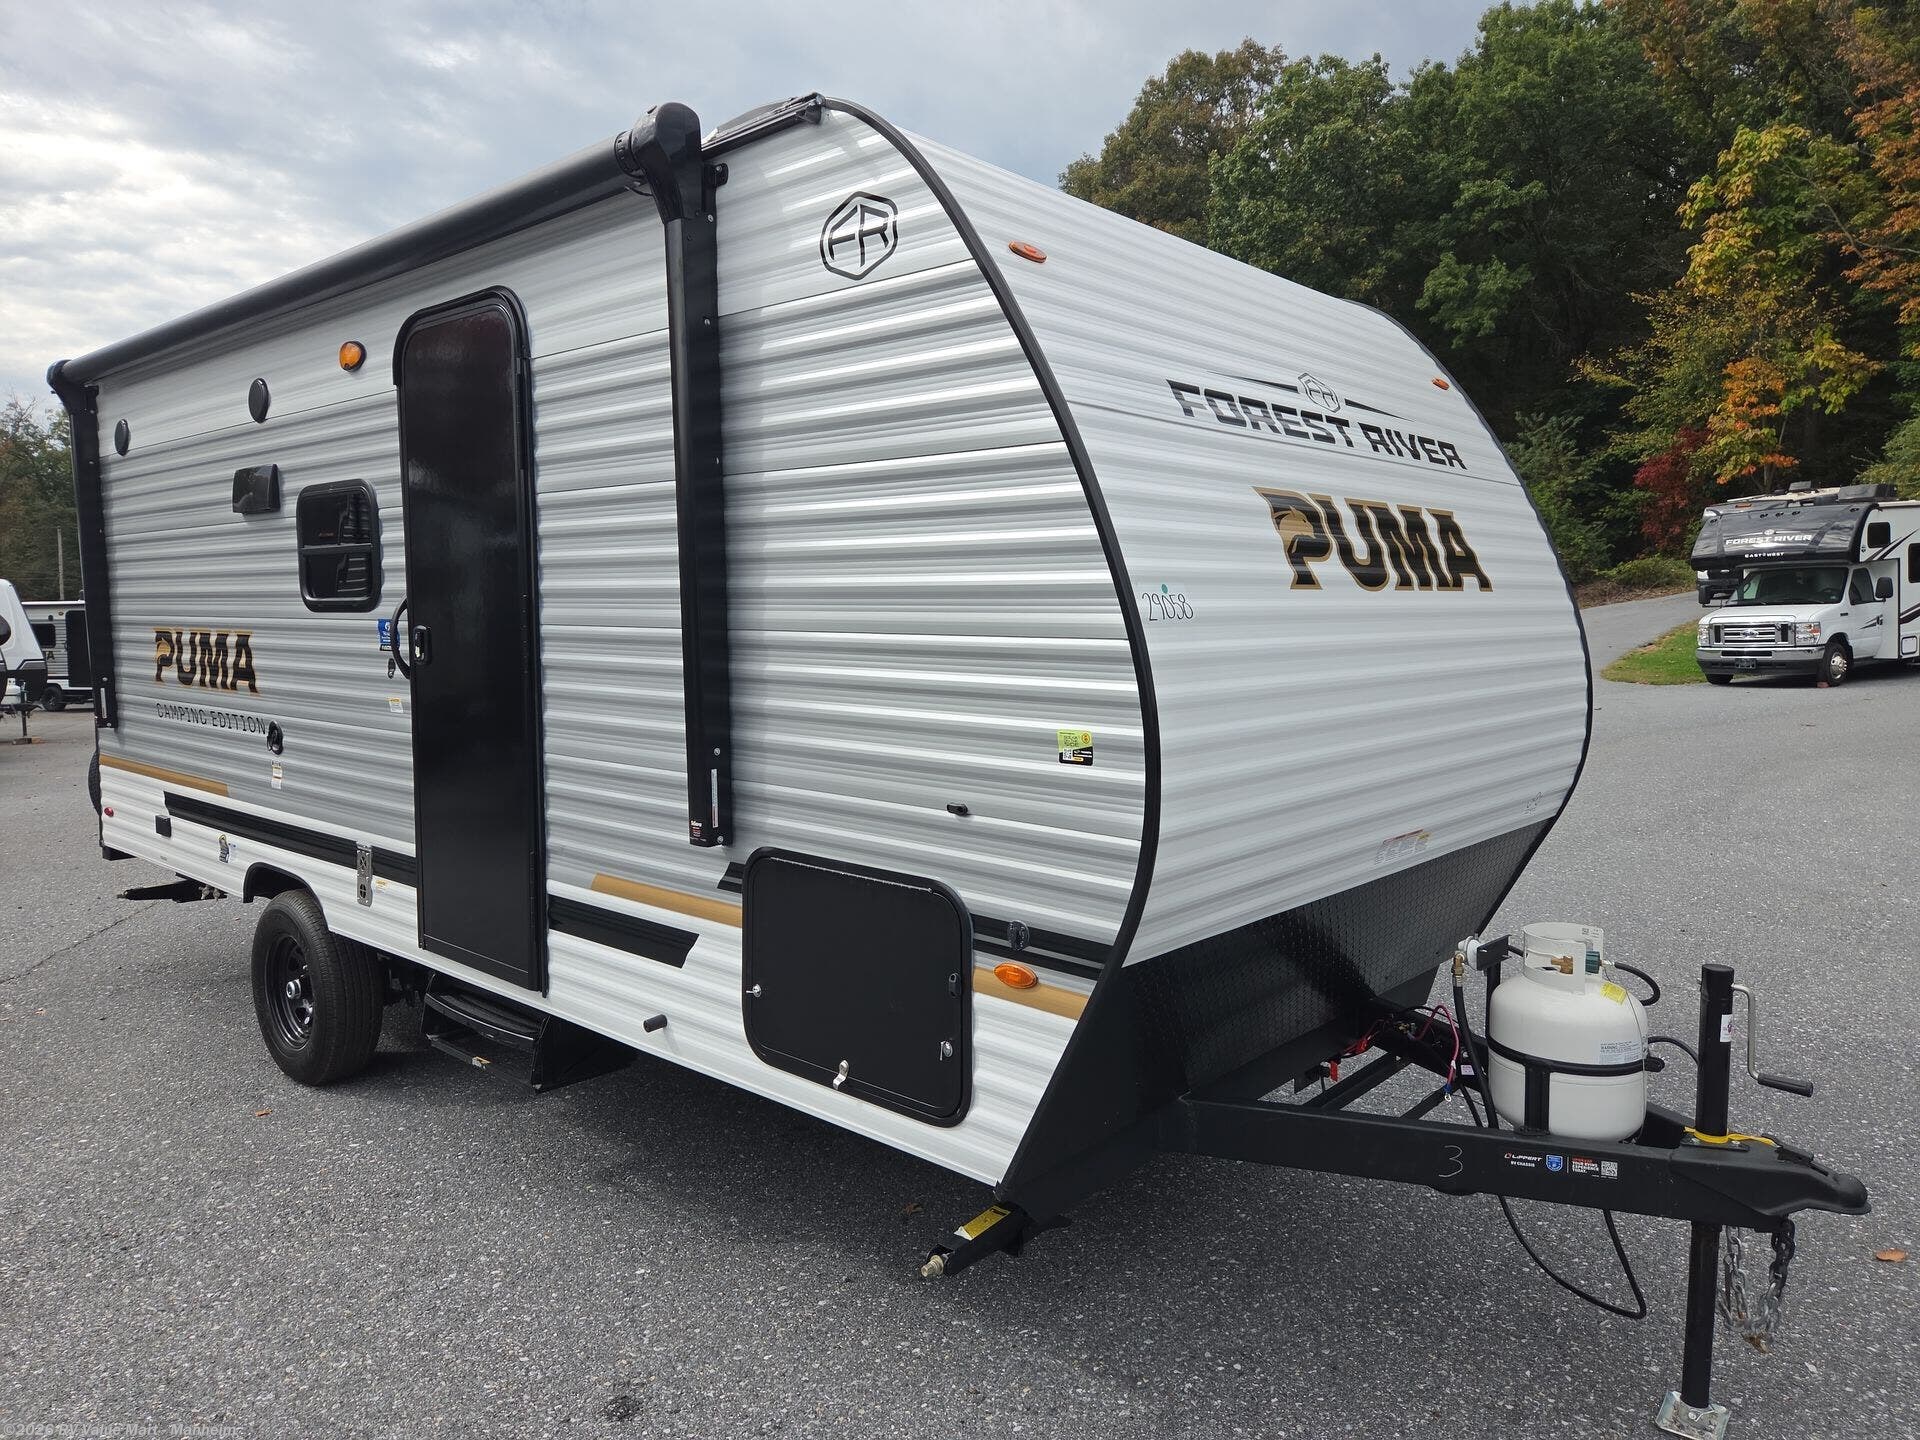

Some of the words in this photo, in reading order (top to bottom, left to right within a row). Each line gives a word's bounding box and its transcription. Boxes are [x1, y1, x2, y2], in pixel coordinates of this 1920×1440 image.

[1166, 379, 1354, 448] FOREST
[1358, 422, 1468, 470] RIVER
[1251, 486, 1493, 592] PUMA
[1725, 536, 1772, 545] FOREST
[1774, 534, 1813, 542] RIVER
[1141, 592, 1194, 621] 29058
[153, 628, 260, 697] PUMA
[156, 703, 207, 725] CAMPING
[209, 711, 266, 735] EDITION
[1438, 1145, 1463, 1178] 3
